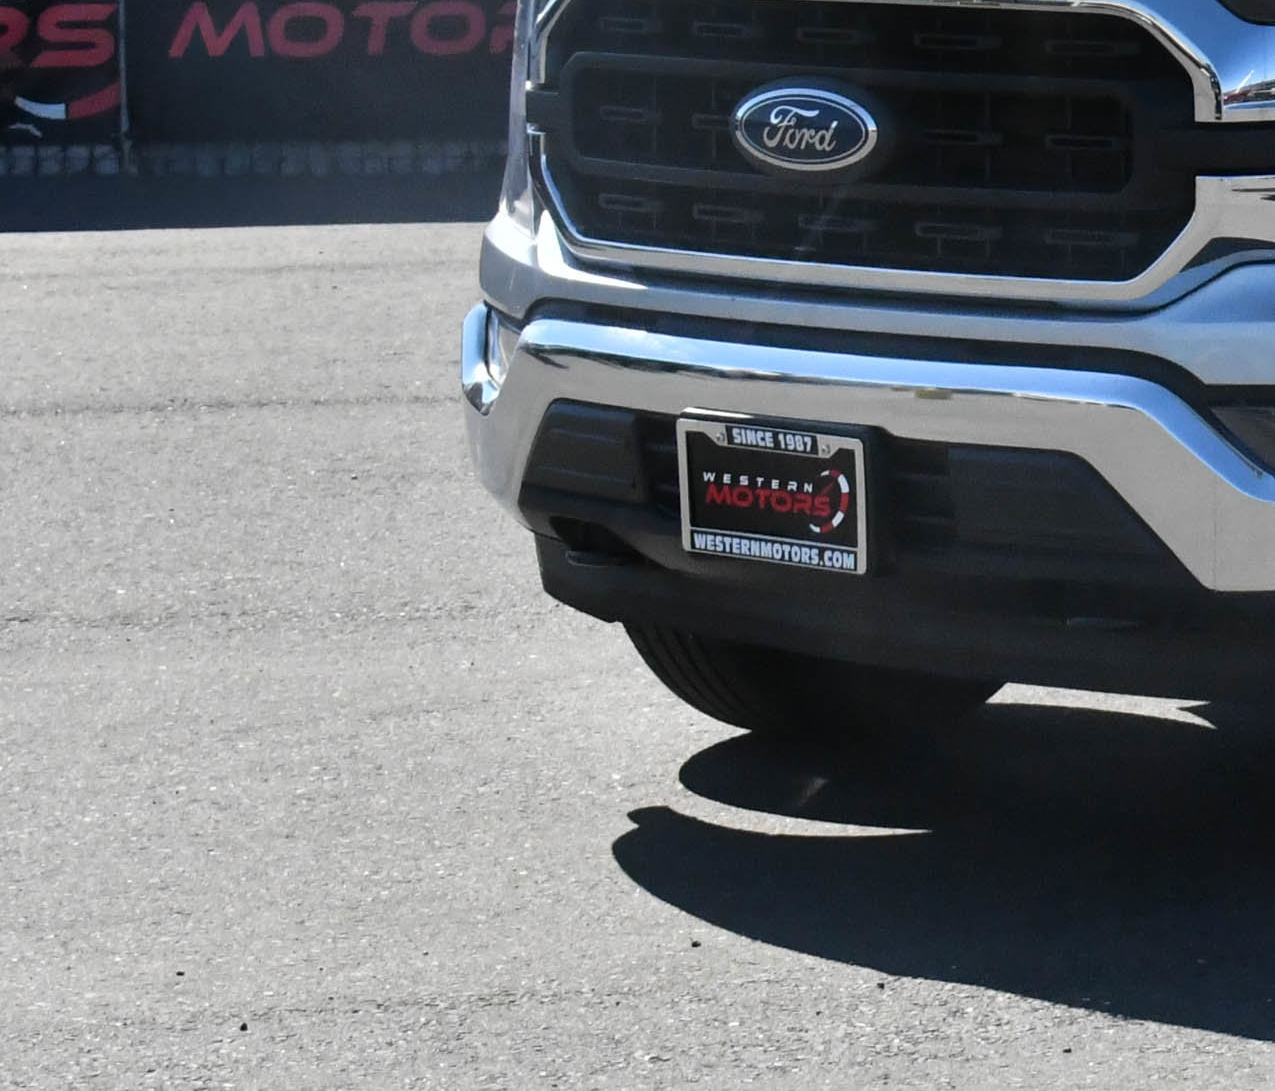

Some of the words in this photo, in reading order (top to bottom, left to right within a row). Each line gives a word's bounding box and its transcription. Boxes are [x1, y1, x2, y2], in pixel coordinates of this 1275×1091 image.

[763, 105, 838, 151] Ford
[731, 428, 775, 448] SINCE
[778, 432, 813, 453] 1987
[703, 471, 814, 493] WESTERN
[705, 483, 832, 518] MOTORS
[693, 532, 856, 570] WESTERNMOTORS.COM
